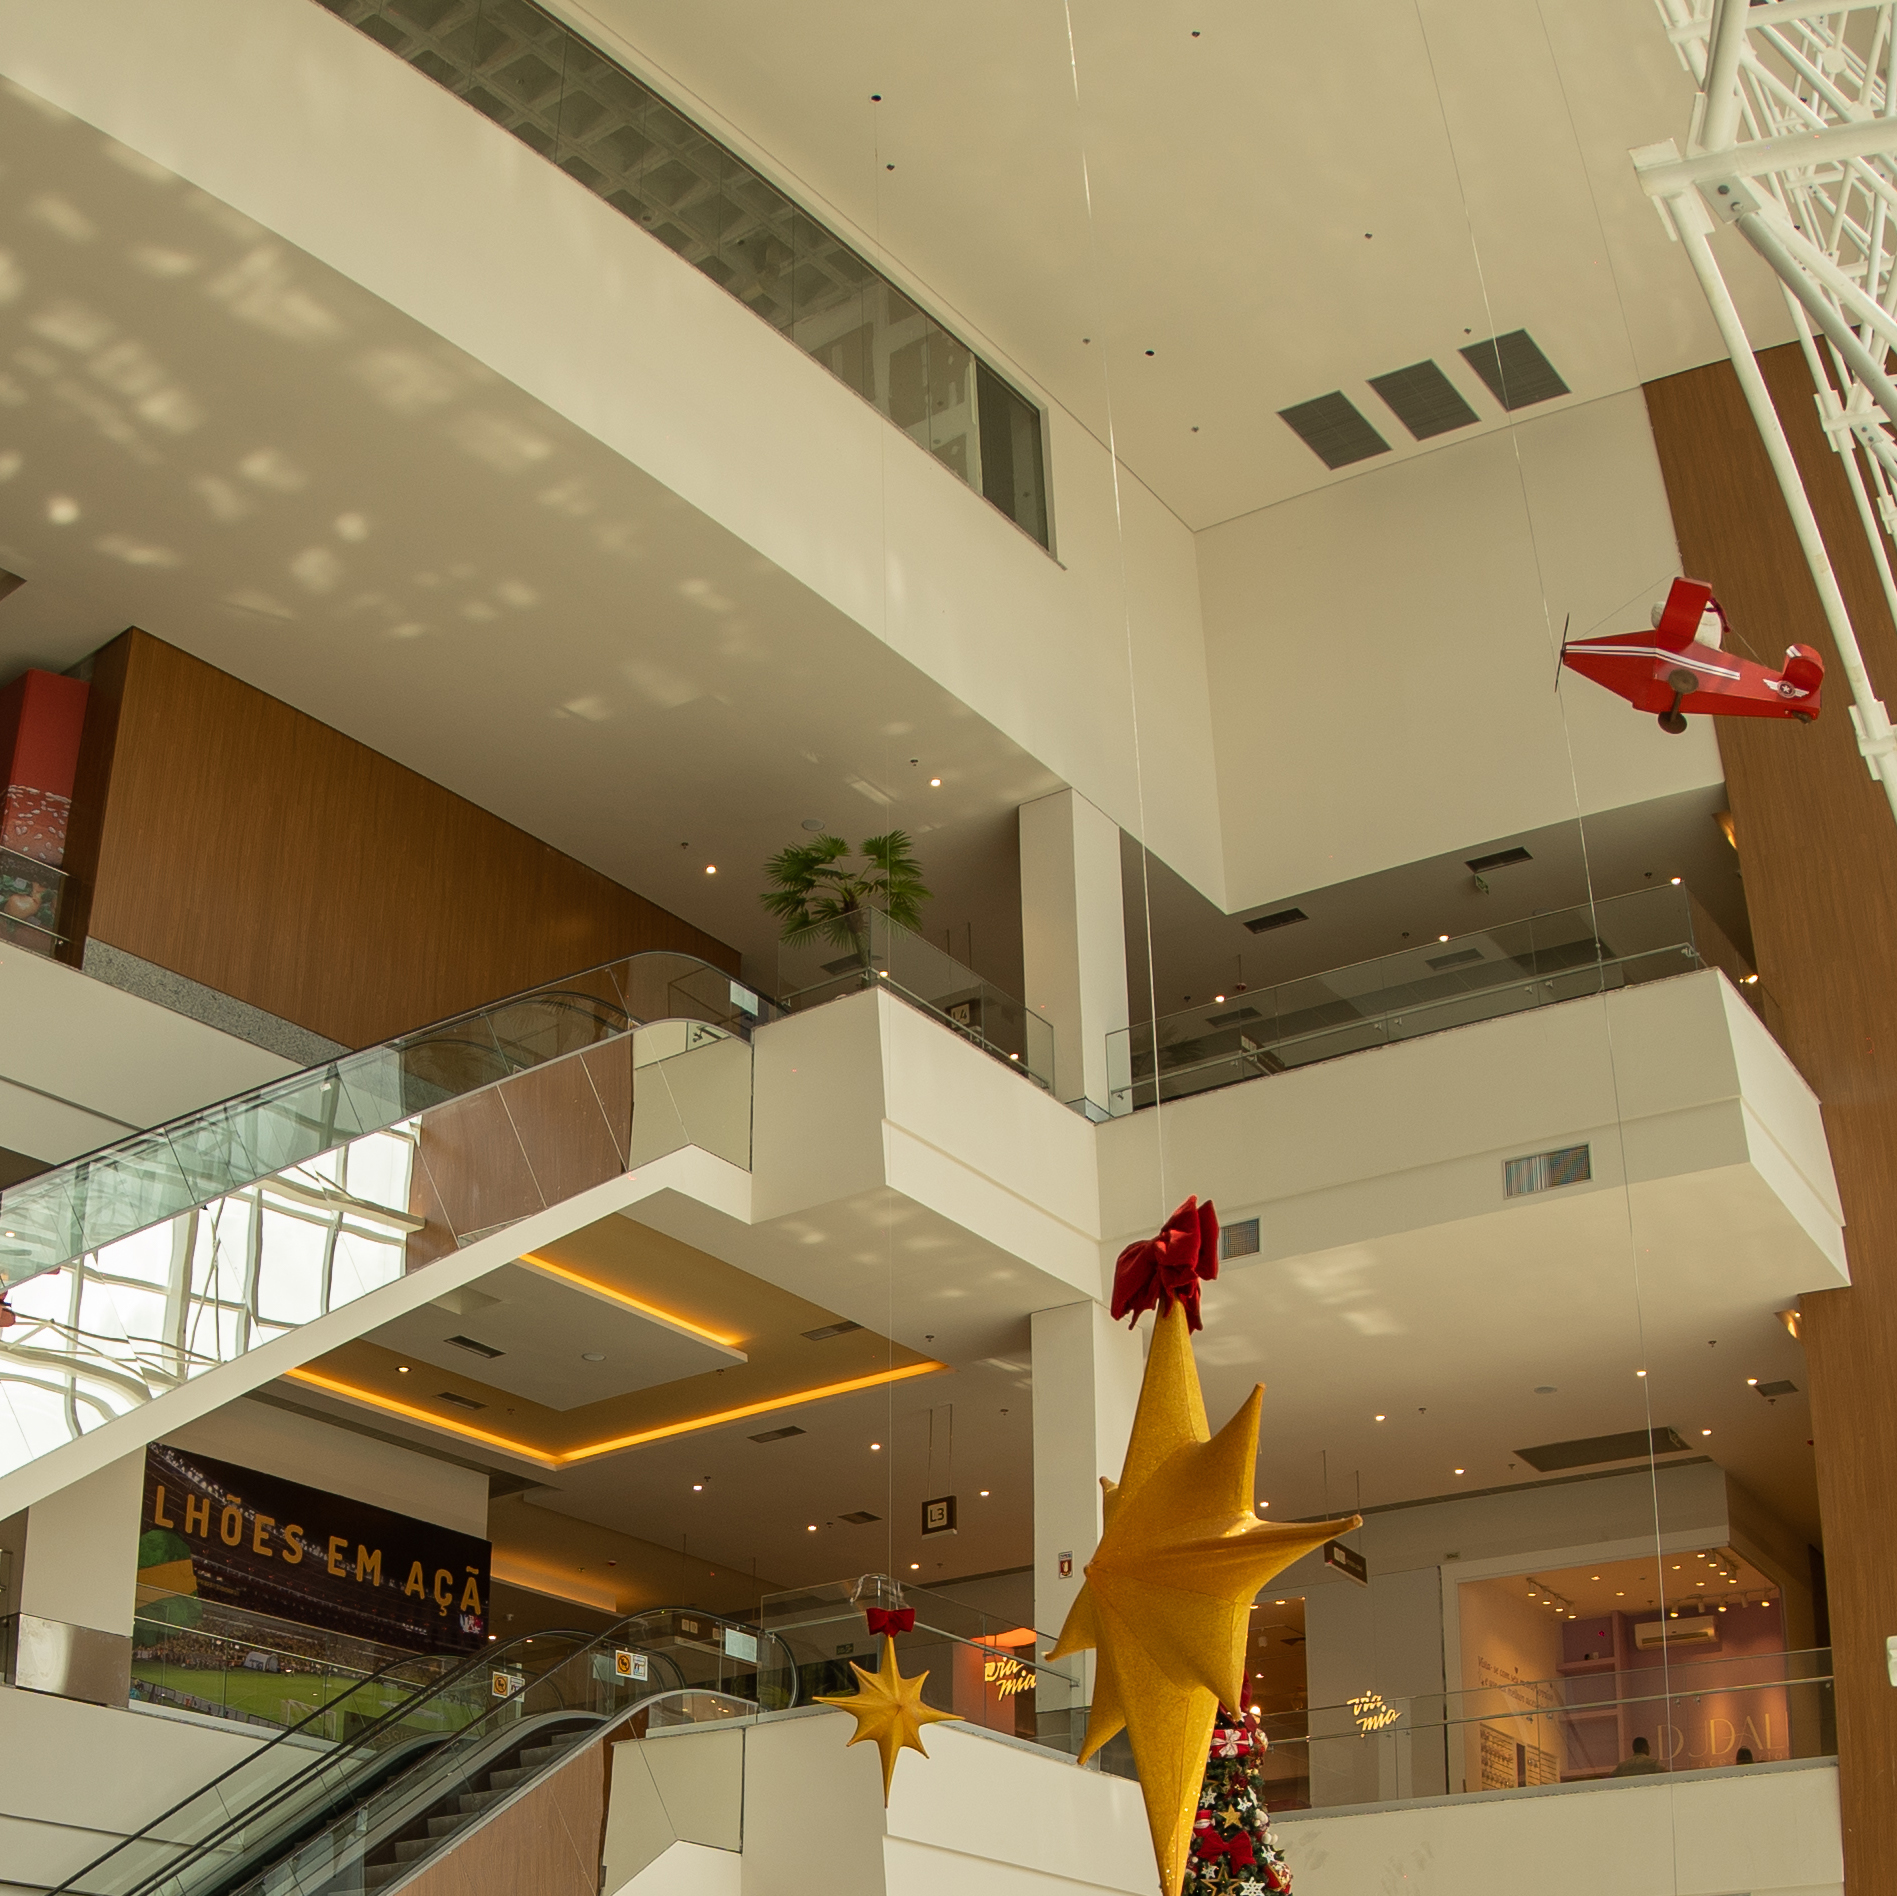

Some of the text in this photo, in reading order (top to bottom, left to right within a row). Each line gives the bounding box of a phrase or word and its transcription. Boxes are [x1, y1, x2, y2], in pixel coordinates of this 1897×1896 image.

[930, 1508, 944, 1522] L3
[155, 1485, 481, 1617] LHÕES EM AÇÃ
[996, 1671, 1036, 1701] mia
[1347, 1690, 1383, 1715] via
[1356, 1705, 1402, 1736] mia
